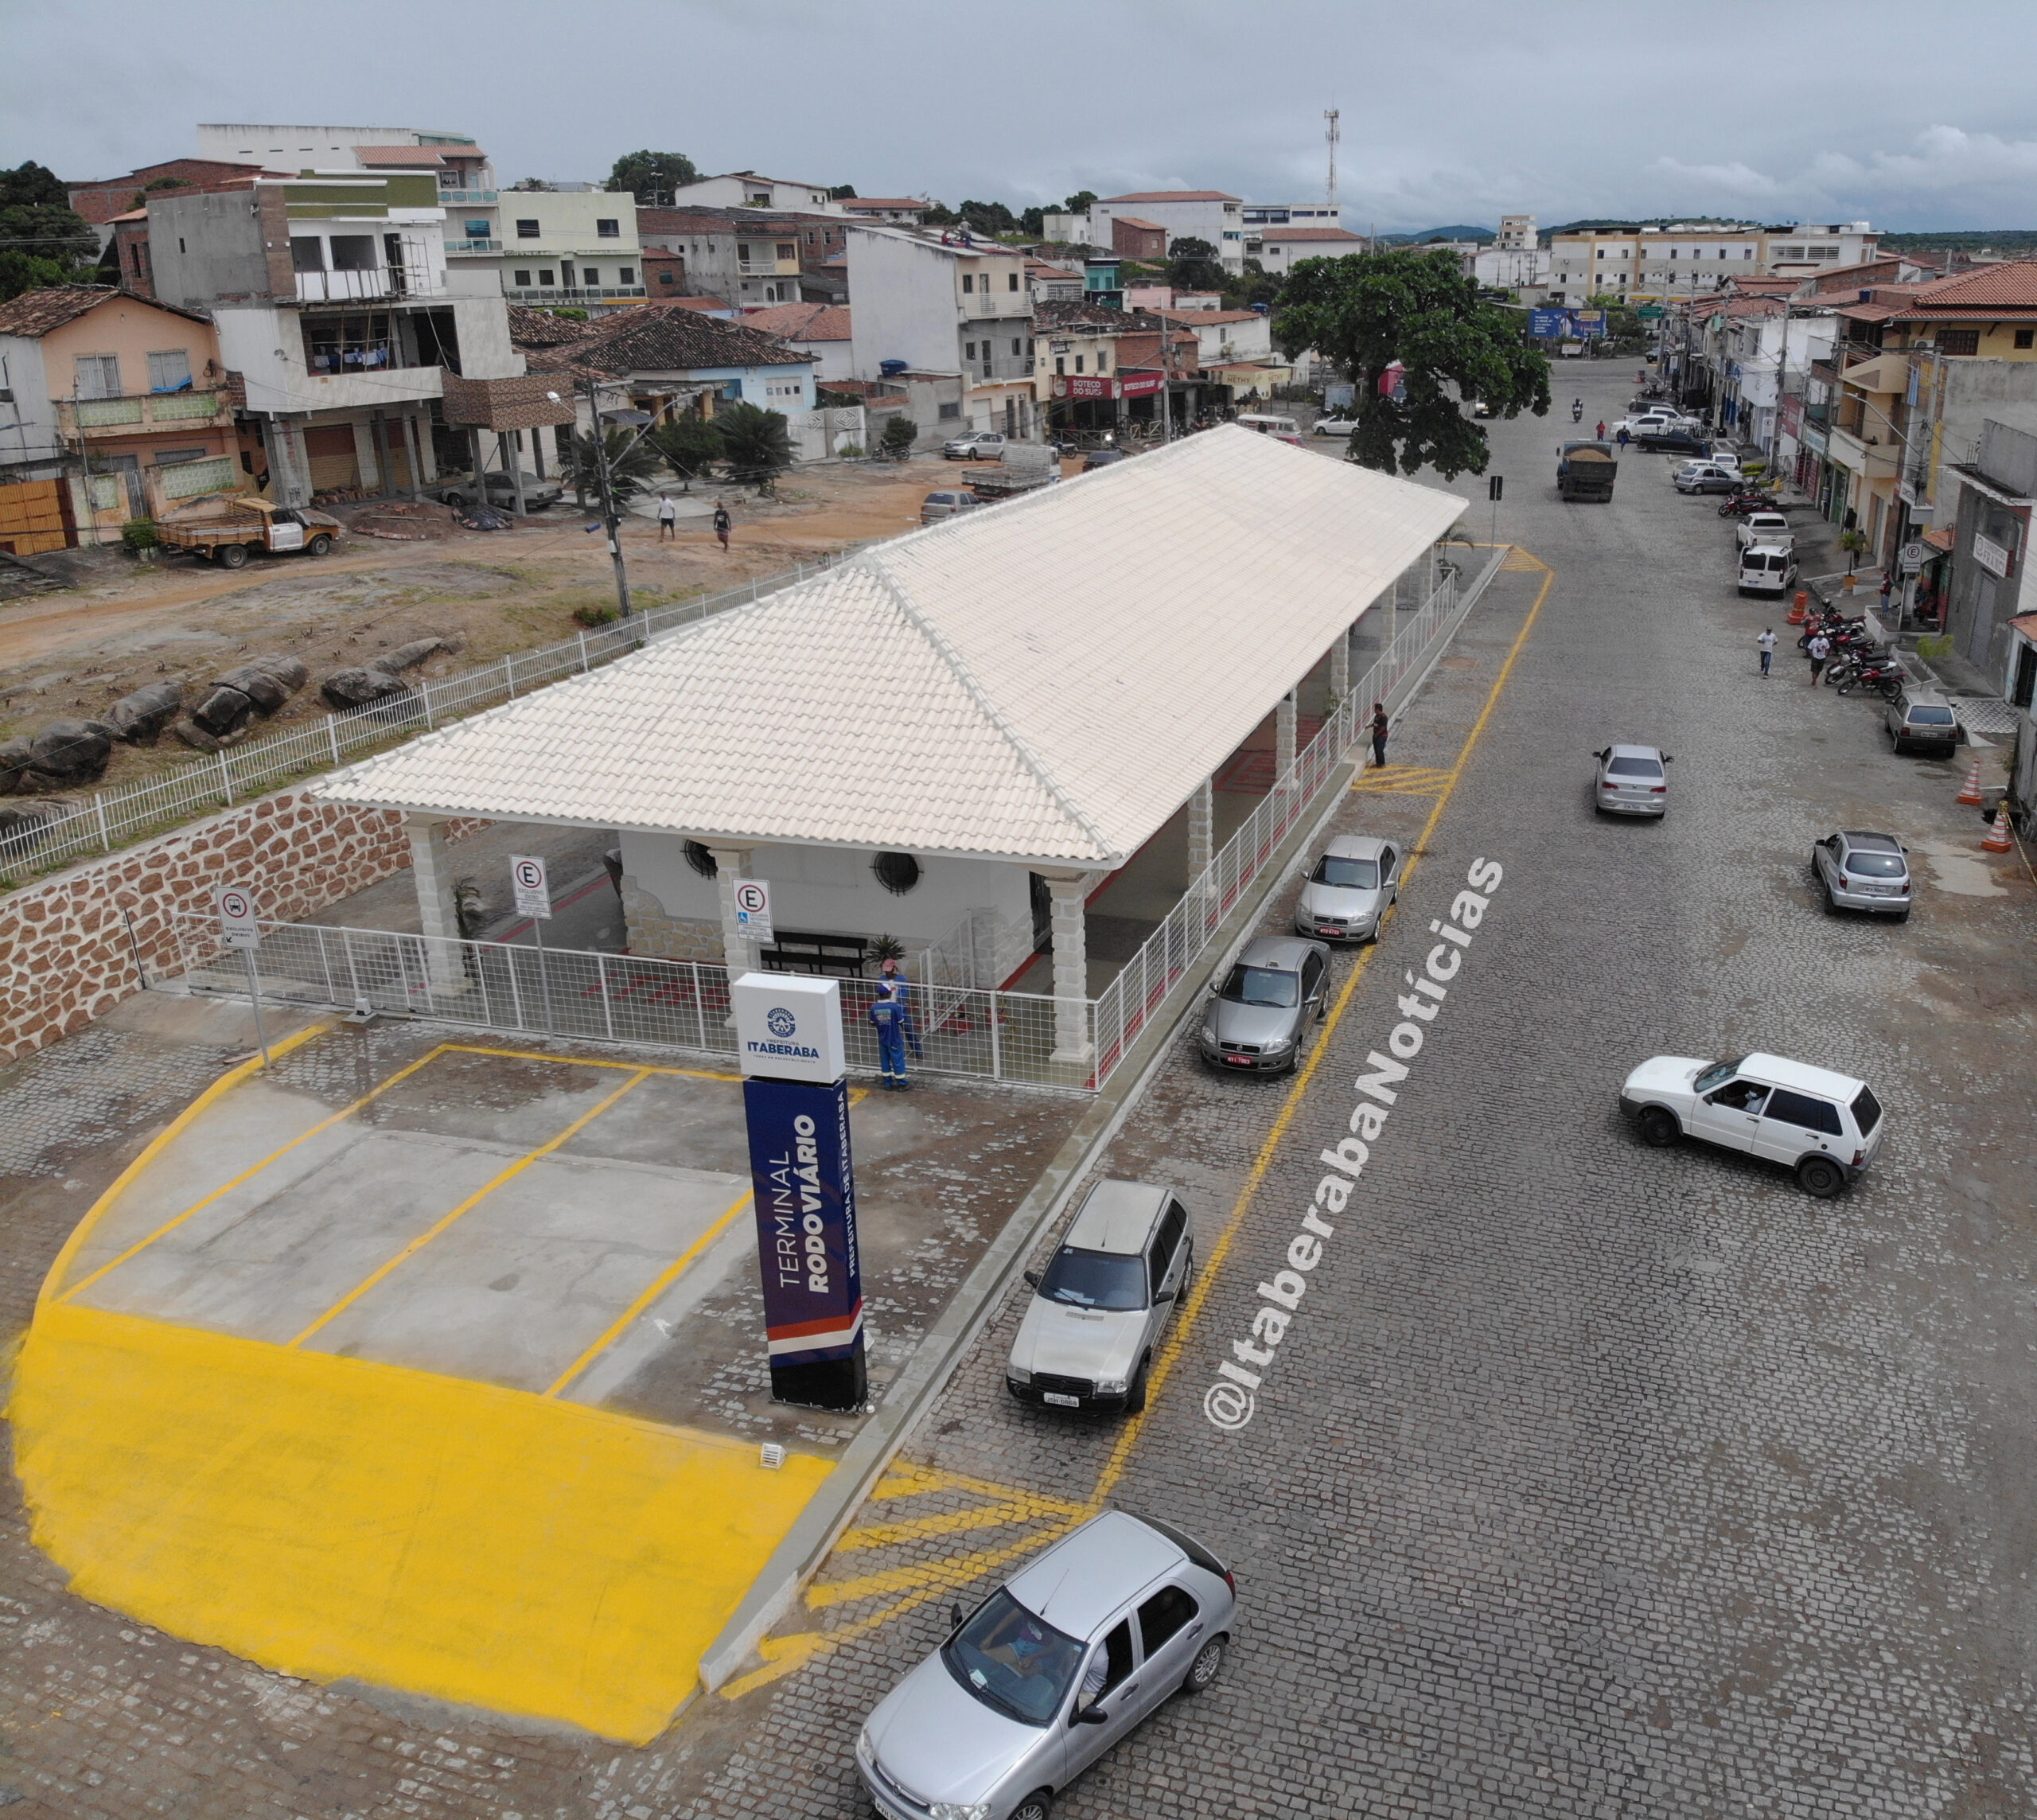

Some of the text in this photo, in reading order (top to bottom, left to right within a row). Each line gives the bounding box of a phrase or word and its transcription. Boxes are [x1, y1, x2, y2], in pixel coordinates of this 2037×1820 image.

[1073, 380, 1101, 388] BOTECO
[523, 867, 535, 883] E
[746, 890, 758, 907] E
[747, 1041, 820, 1059] ITABERABA
[838, 1091, 855, 1278] PREFEITURA DE ITABERABA
[793, 1114, 829, 1293] RODOVIÁRIO
[769, 1151, 800, 1288] TERMINAL
